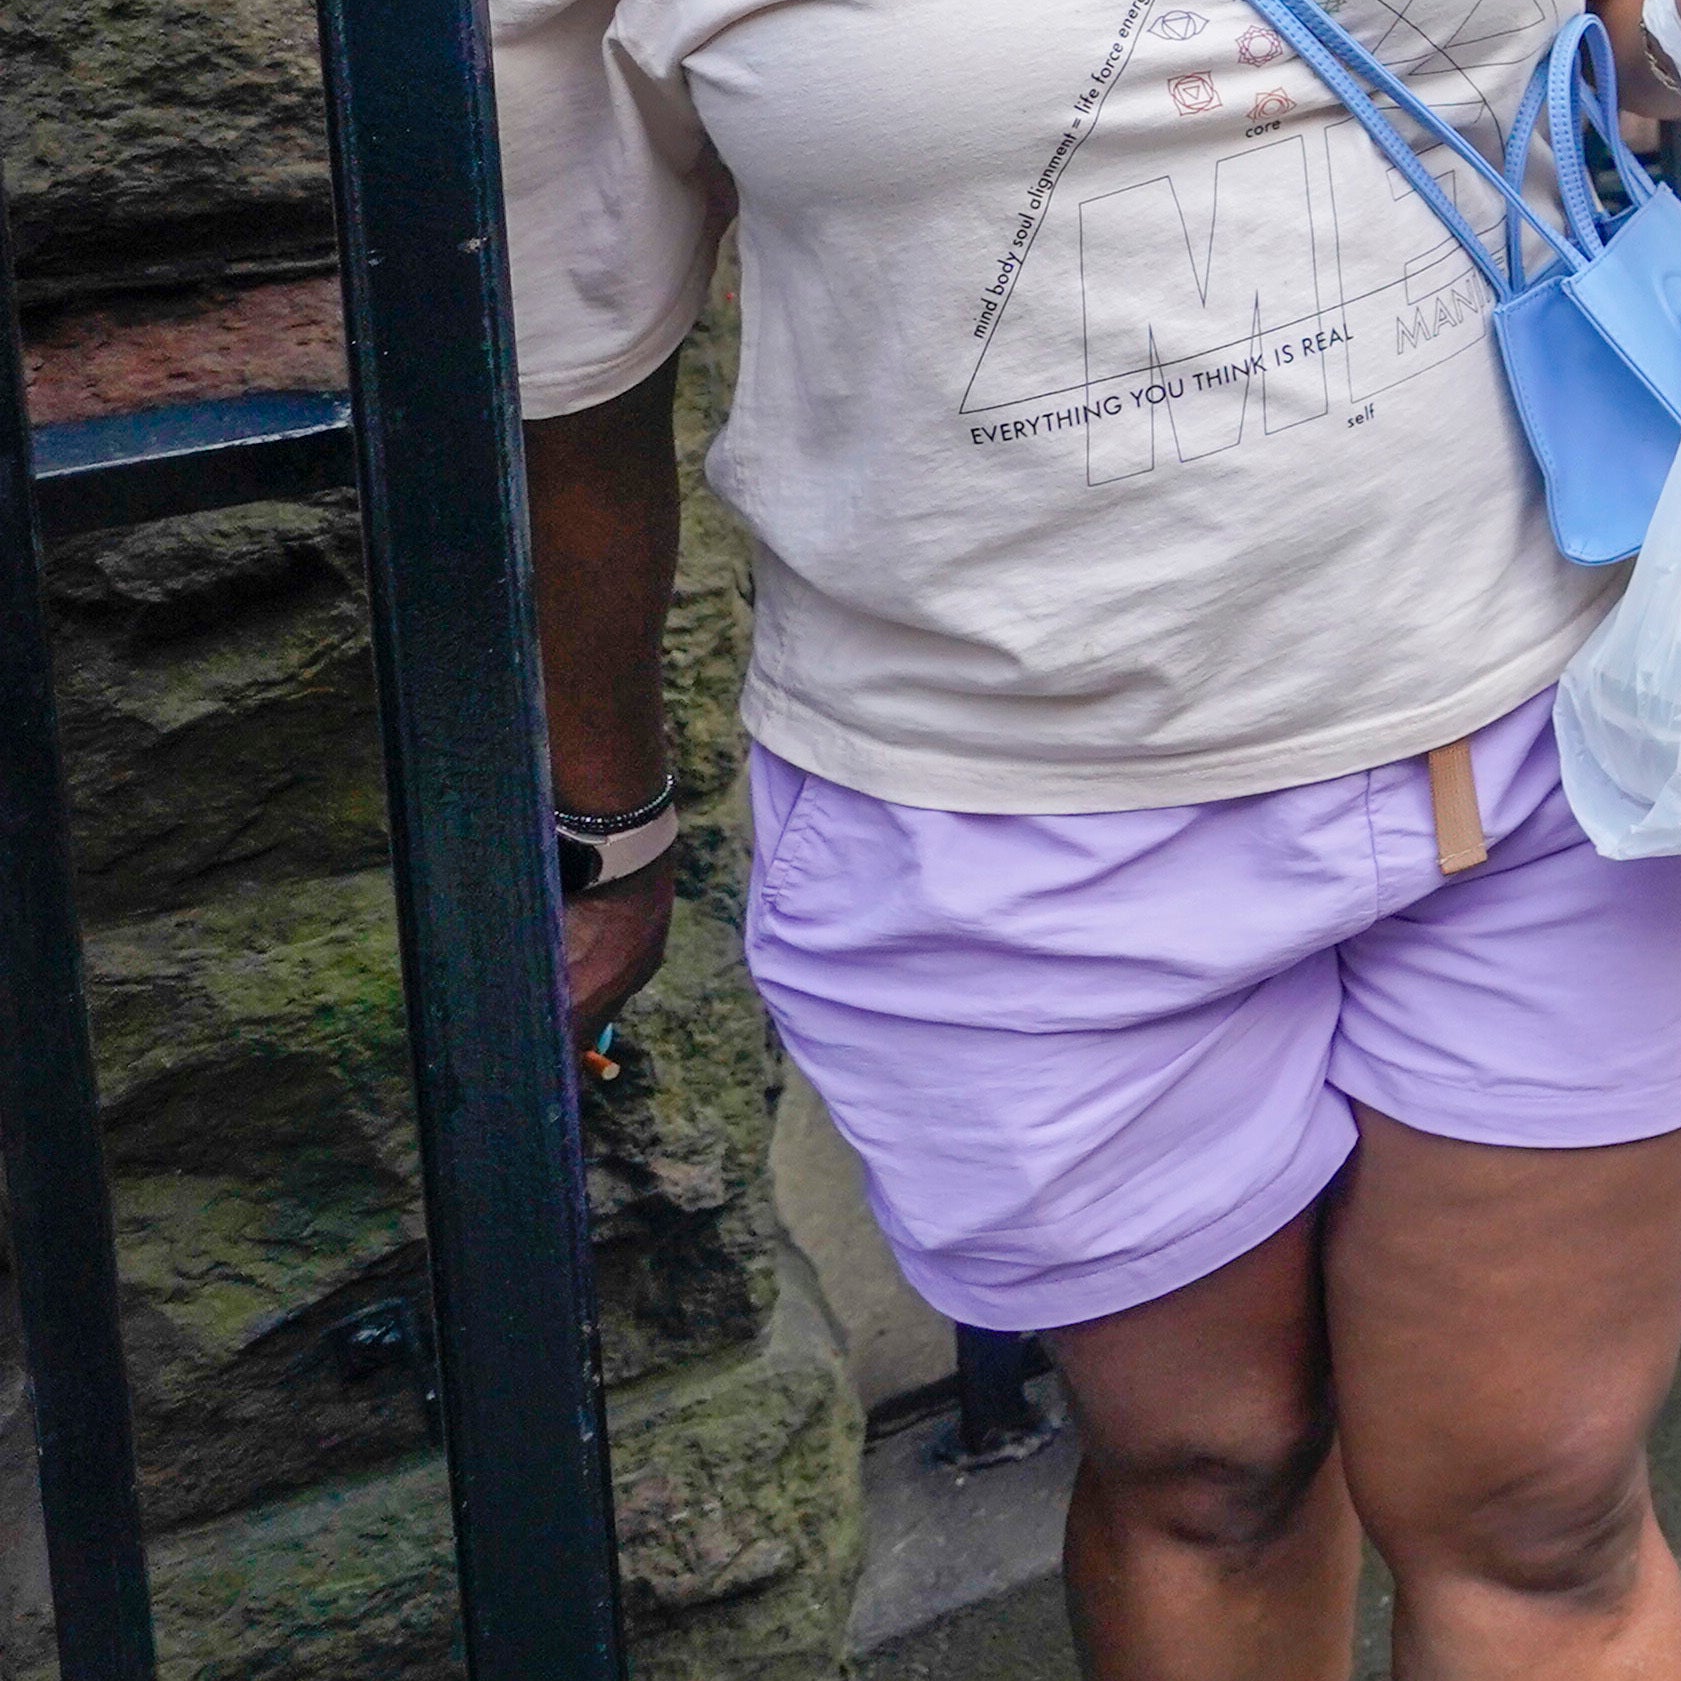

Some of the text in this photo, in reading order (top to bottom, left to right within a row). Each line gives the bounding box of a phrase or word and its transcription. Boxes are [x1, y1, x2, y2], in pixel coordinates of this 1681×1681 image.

[1091, 42, 1124, 85] force
[1073, 88, 1101, 115] life
[1245, 120, 1282, 138] core
[1027, 132, 1077, 211] alignment
[1012, 212, 1036, 248] soul
[985, 251, 1023, 296] body
[973, 298, 998, 338] mind
[970, 323, 1354, 445] EVERYTHING YOU THINK IS REAL
[1347, 402, 1376, 429] self
